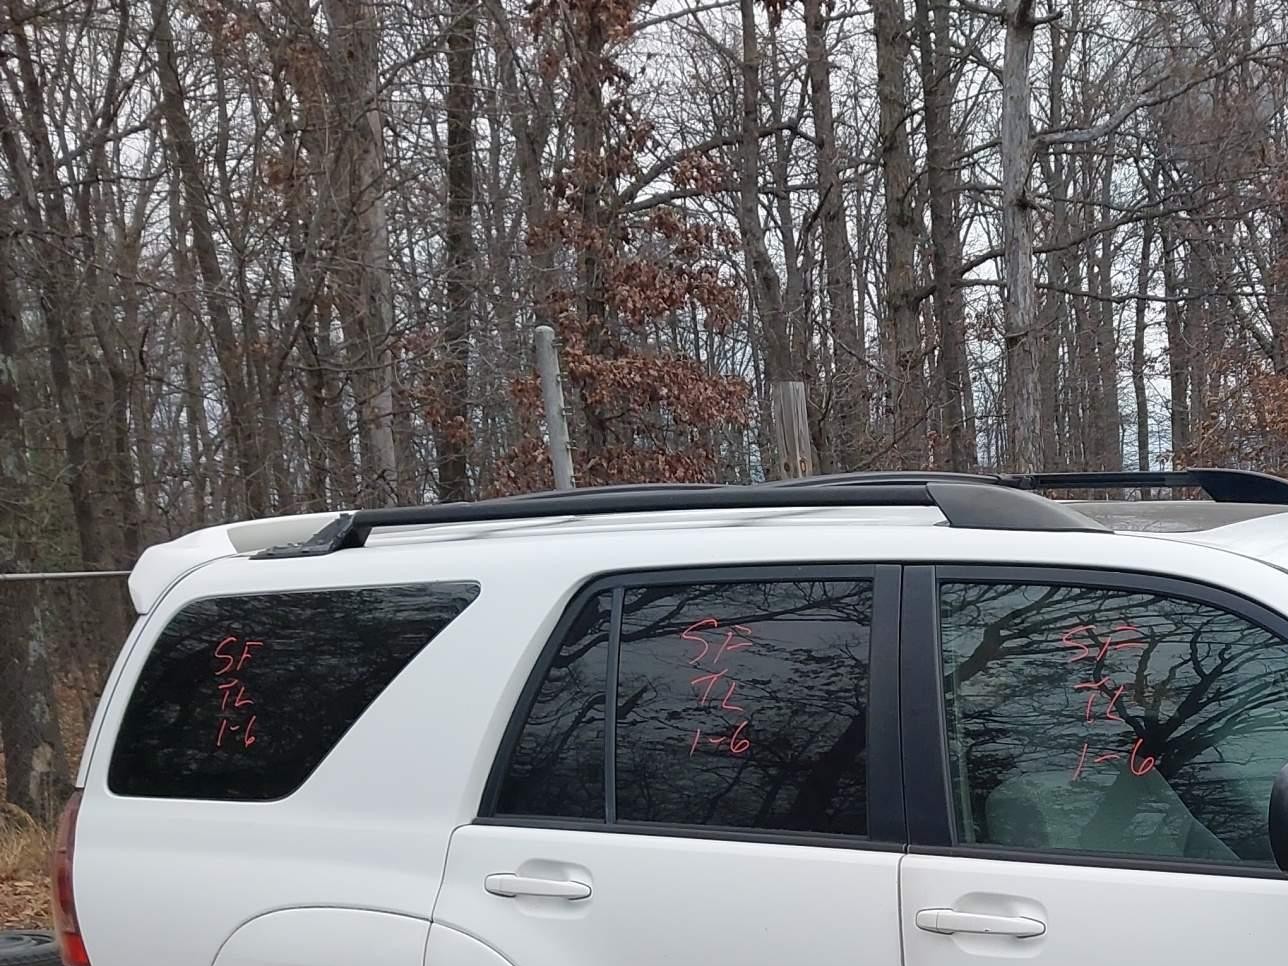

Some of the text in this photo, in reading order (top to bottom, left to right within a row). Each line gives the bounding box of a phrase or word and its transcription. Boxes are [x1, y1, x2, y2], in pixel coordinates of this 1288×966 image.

[214, 636, 264, 675] SF
[218, 679, 254, 710] TL
[691, 668, 744, 711] TL
[217, 715, 257, 748] 1-6
[689, 720, 750, 758] 1-6
[1072, 738, 1155, 781] 1-6
